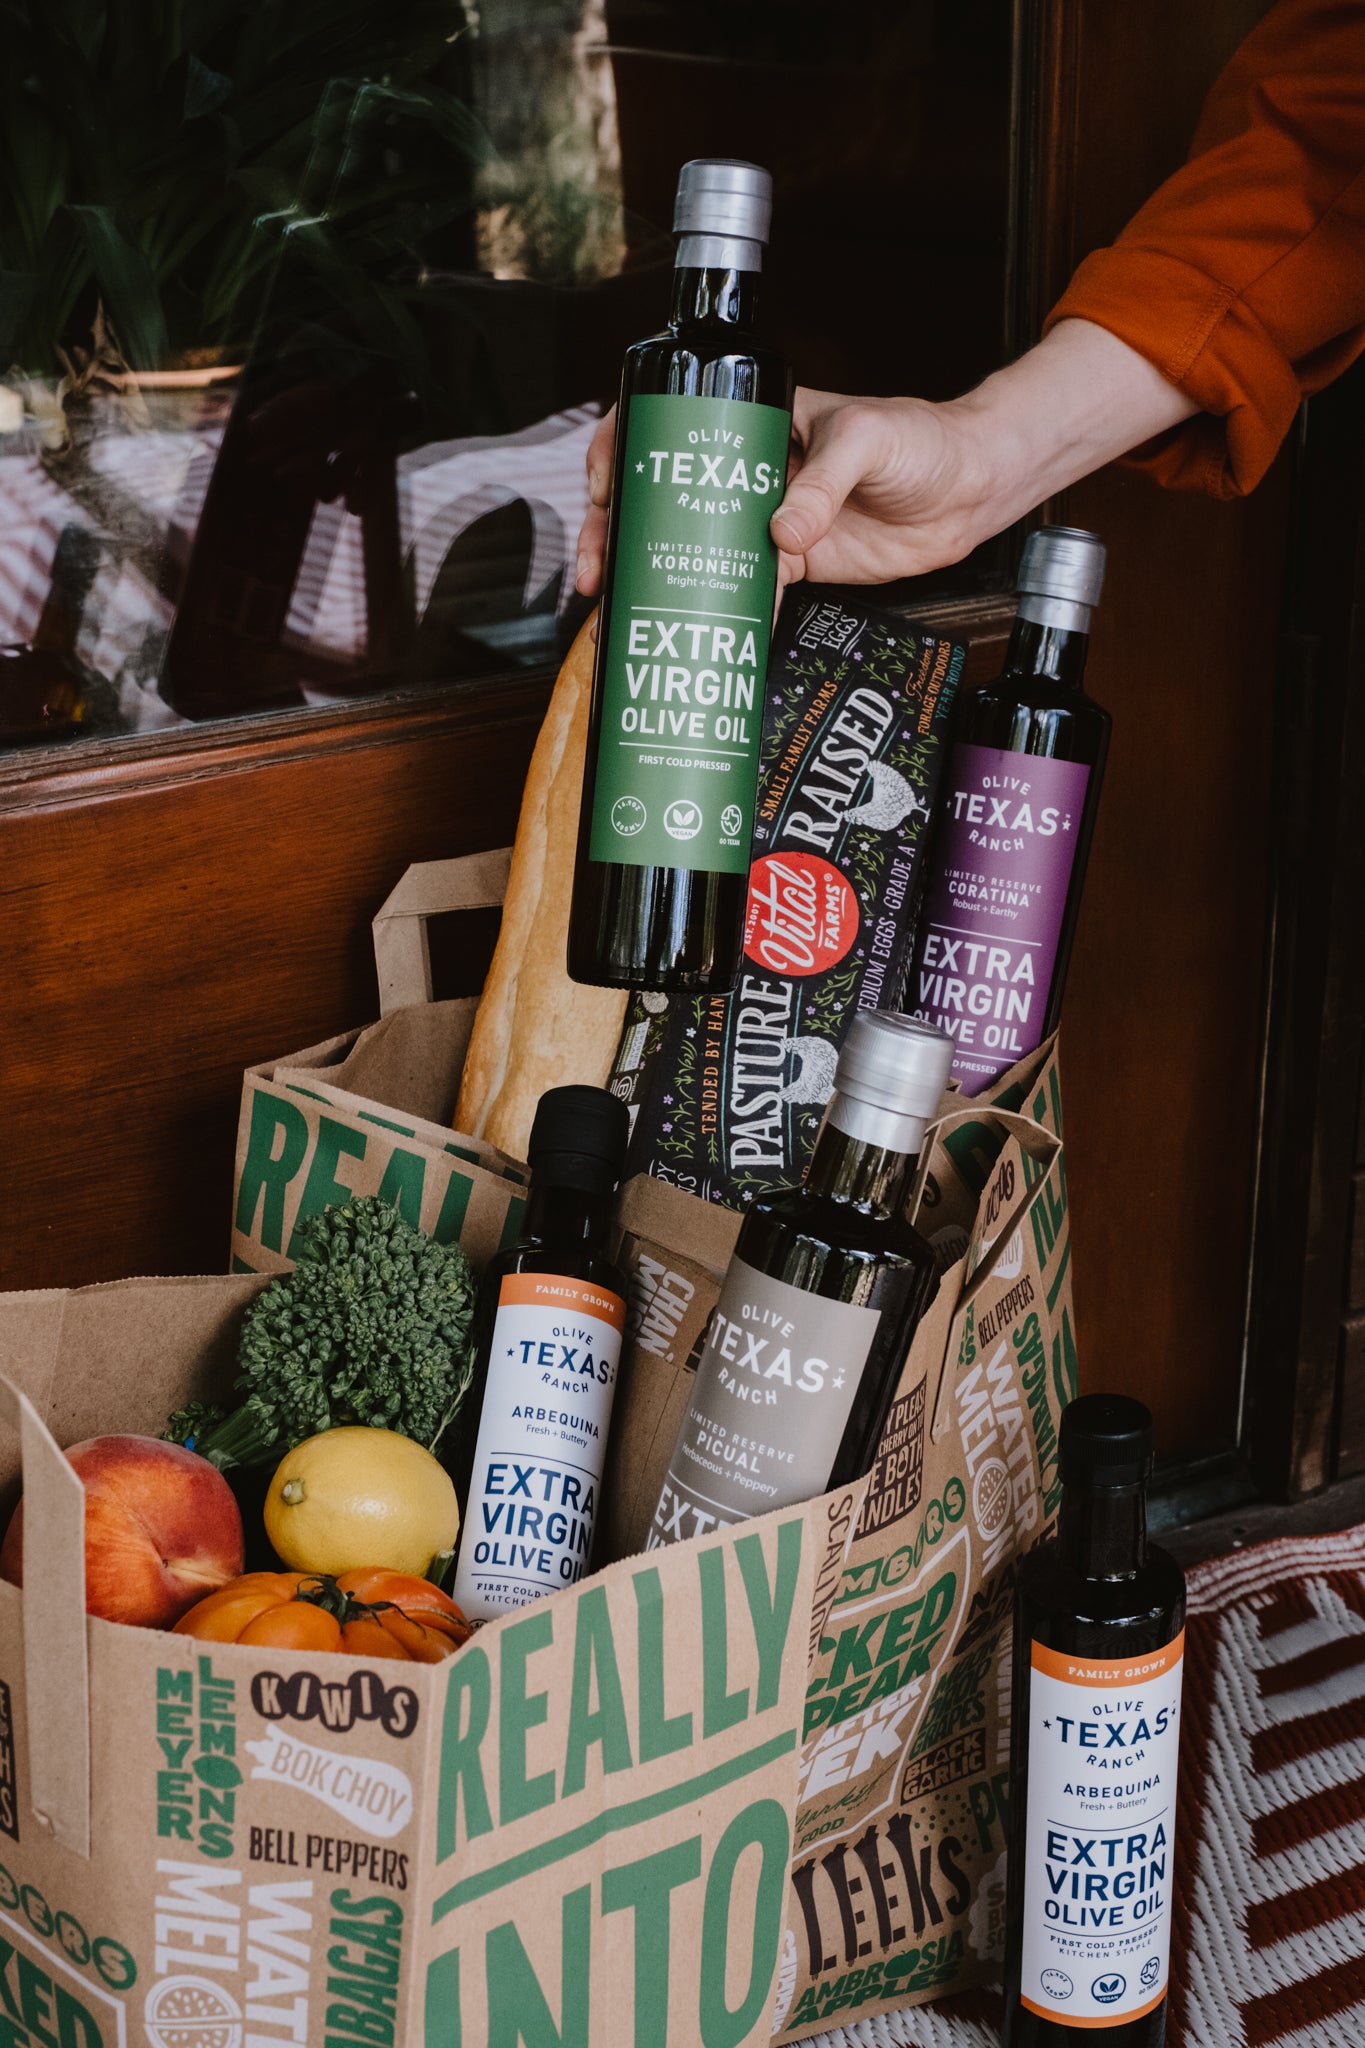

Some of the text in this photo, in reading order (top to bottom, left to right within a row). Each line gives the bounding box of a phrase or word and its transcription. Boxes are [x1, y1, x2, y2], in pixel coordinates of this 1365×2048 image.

[688, 429, 744, 449] OLIVE
[649, 451, 771, 495] TEXAS
[677, 492, 742, 514] RANCH
[647, 542, 760, 562] LIMITED RESERVE
[651, 554, 753, 579] KORONEIKI
[667, 574, 697, 588] Bright
[708, 579, 739, 592] Grassy
[627, 619, 757, 667] EXTRA
[799, 602, 842, 650] ETHICAL
[821, 614, 859, 650] EGGS
[625, 662, 756, 711] VIRGIN
[905, 648, 934, 701] Freedom
[918, 639, 951, 736] FORAGE OUTDOORS
[935, 645, 967, 720] YEAR ROUND
[621, 706, 750, 744] OLIVE OIL
[638, 754, 731, 772] FIRST COLD PRESSED
[754, 680, 838, 840] ON SMALL FAMILY FARMS
[783, 687, 894, 854] RAISED
[982, 775, 1031, 796] OLIVE
[671, 829, 693, 837] VEGAN
[953, 791, 1060, 837] TEXAS
[898, 845, 916, 858] A
[968, 829, 1025, 853] RANCH
[882, 857, 912, 910] GRADE
[944, 868, 1042, 894] LIMITED RESERVE
[948, 880, 1030, 907] CORATINA
[749, 903, 761, 926] 2007
[751, 859, 817, 971] Vital
[953, 898, 981, 913] Robust
[989, 906, 1019, 920] Earthy
[871, 916, 898, 959] EGGS
[922, 934, 1035, 986] EXTRA
[919, 970, 1033, 1024] VIRGIN
[983, 1024, 1023, 1052] OIL
[701, 996, 725, 1134] TENDED BY HAN
[729, 974, 794, 1170] PASTURE
[960, 1061, 998, 1074] PRESSED
[535, 1284, 615, 1313] FAMILY GROWN
[977, 1310, 998, 1350] BELL
[995, 1274, 1035, 1331] PEPPERS
[552, 1327, 594, 1346] OLIVE
[741, 1303, 796, 1339] OLIVE
[519, 1340, 611, 1385] TEXAS
[711, 1312, 830, 1394] TEXAS
[541, 1372, 589, 1393] RANCH
[717, 1367, 778, 1405] RANCH
[511, 1405, 599, 1440] ARBEQUINA
[895, 1383, 925, 1432] PLEAS
[526, 1424, 550, 1436] Fresh
[559, 1430, 588, 1449] Buttery
[690, 1407, 796, 1464] LIMITED RESERVE
[696, 1430, 761, 1474] PICUAL
[878, 1430, 908, 1458] CHERRY
[986, 1339, 1039, 1546] WATER
[682, 1441, 724, 1475] Herbaceous
[732, 1471, 779, 1498] Peppery
[884, 1429, 924, 1487] BOTH
[484, 1463, 595, 1521] EXTRA
[655, 1483, 733, 1541] EXT
[853, 1466, 921, 1536] ANDLES
[481, 1502, 592, 1561] VIRGIN
[473, 1541, 554, 1574] OLIVE
[476, 1582, 541, 1599] FIRST COLD
[483, 1594, 534, 1607] KITCHE
[802, 1631, 947, 1745] PEAK
[1067, 1657, 1166, 1679] FAMILY GROWN
[258, 1674, 412, 1734] KIWIS
[436, 1517, 804, 1866] REALLY
[819, 1674, 926, 1749] AFTER
[1092, 1700, 1144, 1716] OLIVE
[1055, 1706, 1169, 1749] TEXAS
[156, 1666, 195, 1842] MEYER
[903, 1731, 982, 1783] BLACK
[1086, 1749, 1146, 1770] RANCH
[271, 1741, 408, 1823] BOK CHOY
[902, 1751, 984, 1802] GARLIC
[1063, 1773, 1161, 1799] ARBEQUINA
[1080, 1801, 1105, 1812] Fresh
[1116, 1796, 1148, 1811] Buttery
[799, 1816, 846, 1849] FOOD
[1046, 1822, 1167, 1868] EXTRA
[249, 1825, 410, 1891] BELL PEPPERS
[1045, 1851, 1166, 1902] VIRGIN
[791, 1812, 972, 1981] LEEKS
[1044, 1890, 1164, 1928] OLIVE OIL
[424, 1798, 790, 2048] INTO
[1049, 1925, 1158, 1949] FIRST COLD PRESSED
[1059, 1938, 1152, 1959] KITCHEN STAPLE
[785, 1960, 960, 2032] APPLES
[1099, 1994, 1119, 2002] VEGAN
